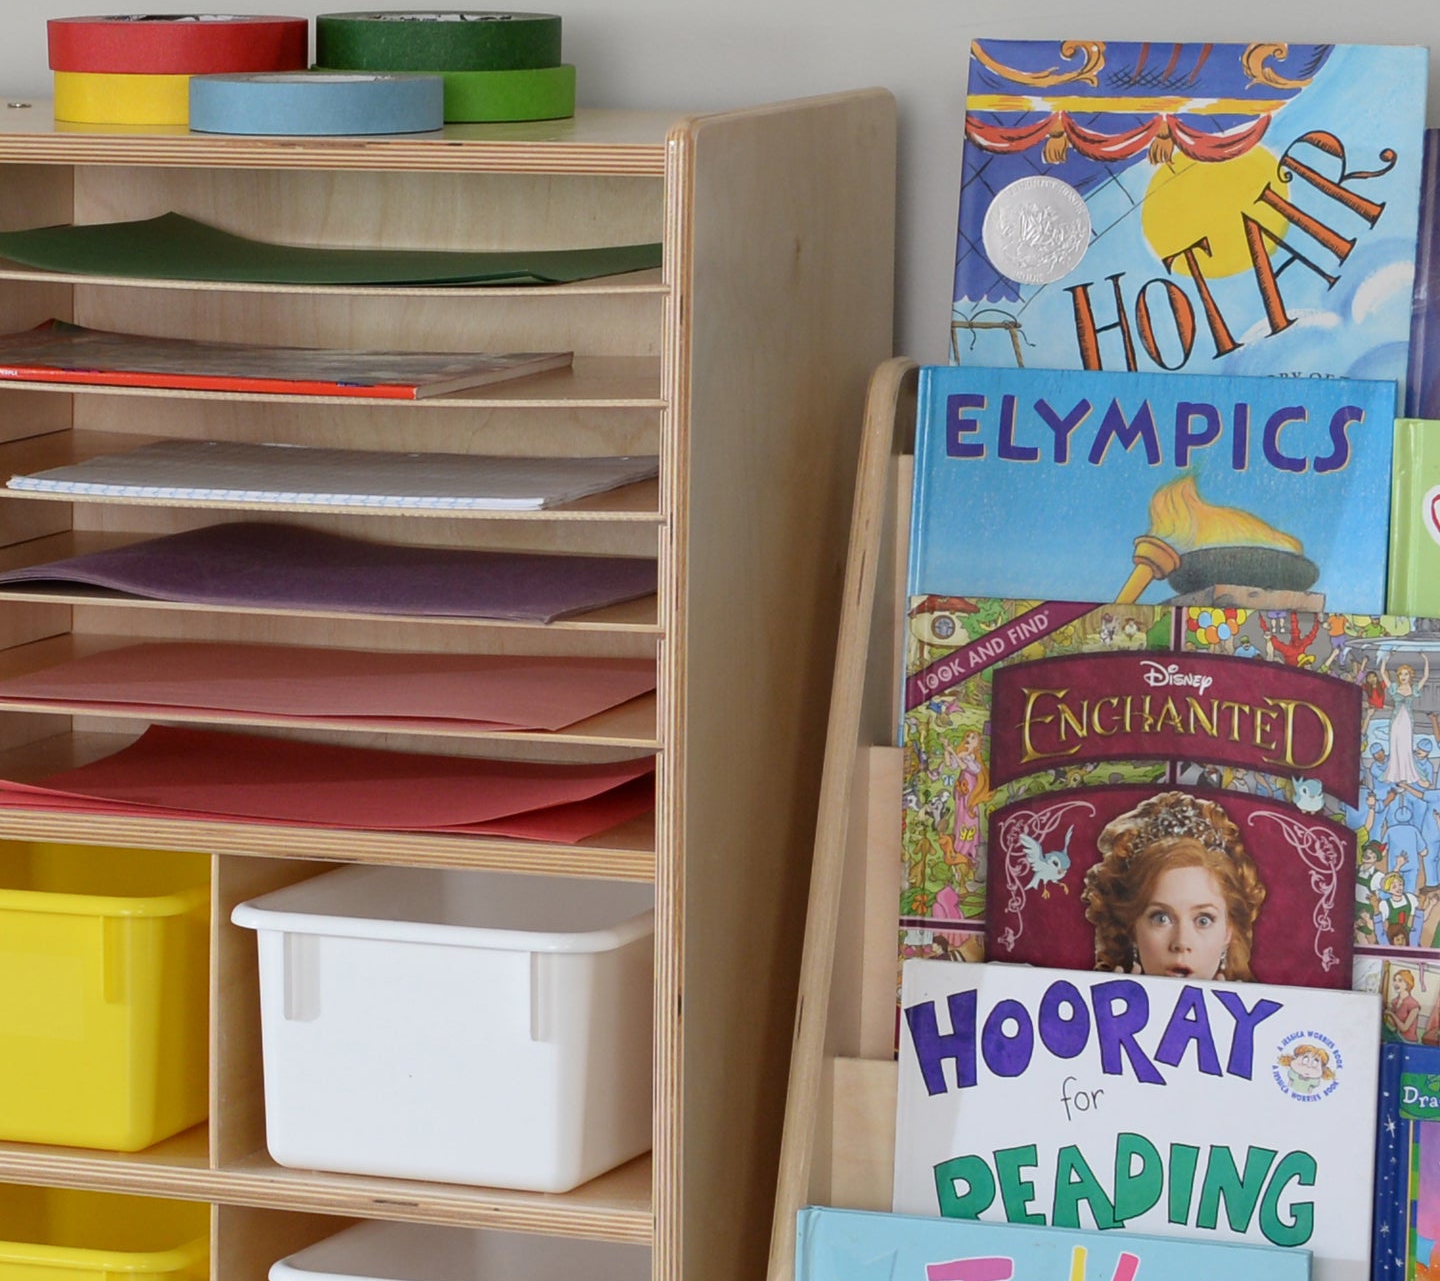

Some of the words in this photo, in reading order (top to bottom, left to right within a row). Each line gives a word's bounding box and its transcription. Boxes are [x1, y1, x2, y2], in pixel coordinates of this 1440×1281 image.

[1063, 237, 1244, 372] HOT
[1241, 129, 1398, 343] AIR
[944, 393, 1366, 473] ELYMPICS
[917, 658, 966, 695] LOOK
[968, 637, 1005, 668] AND
[1139, 659, 1214, 696] Disney
[1019, 686, 1335, 771] ENCHANTED
[903, 978, 1284, 1097] HOORAY
[1059, 1075, 1105, 1122] for
[934, 1131, 1318, 1248] READING
